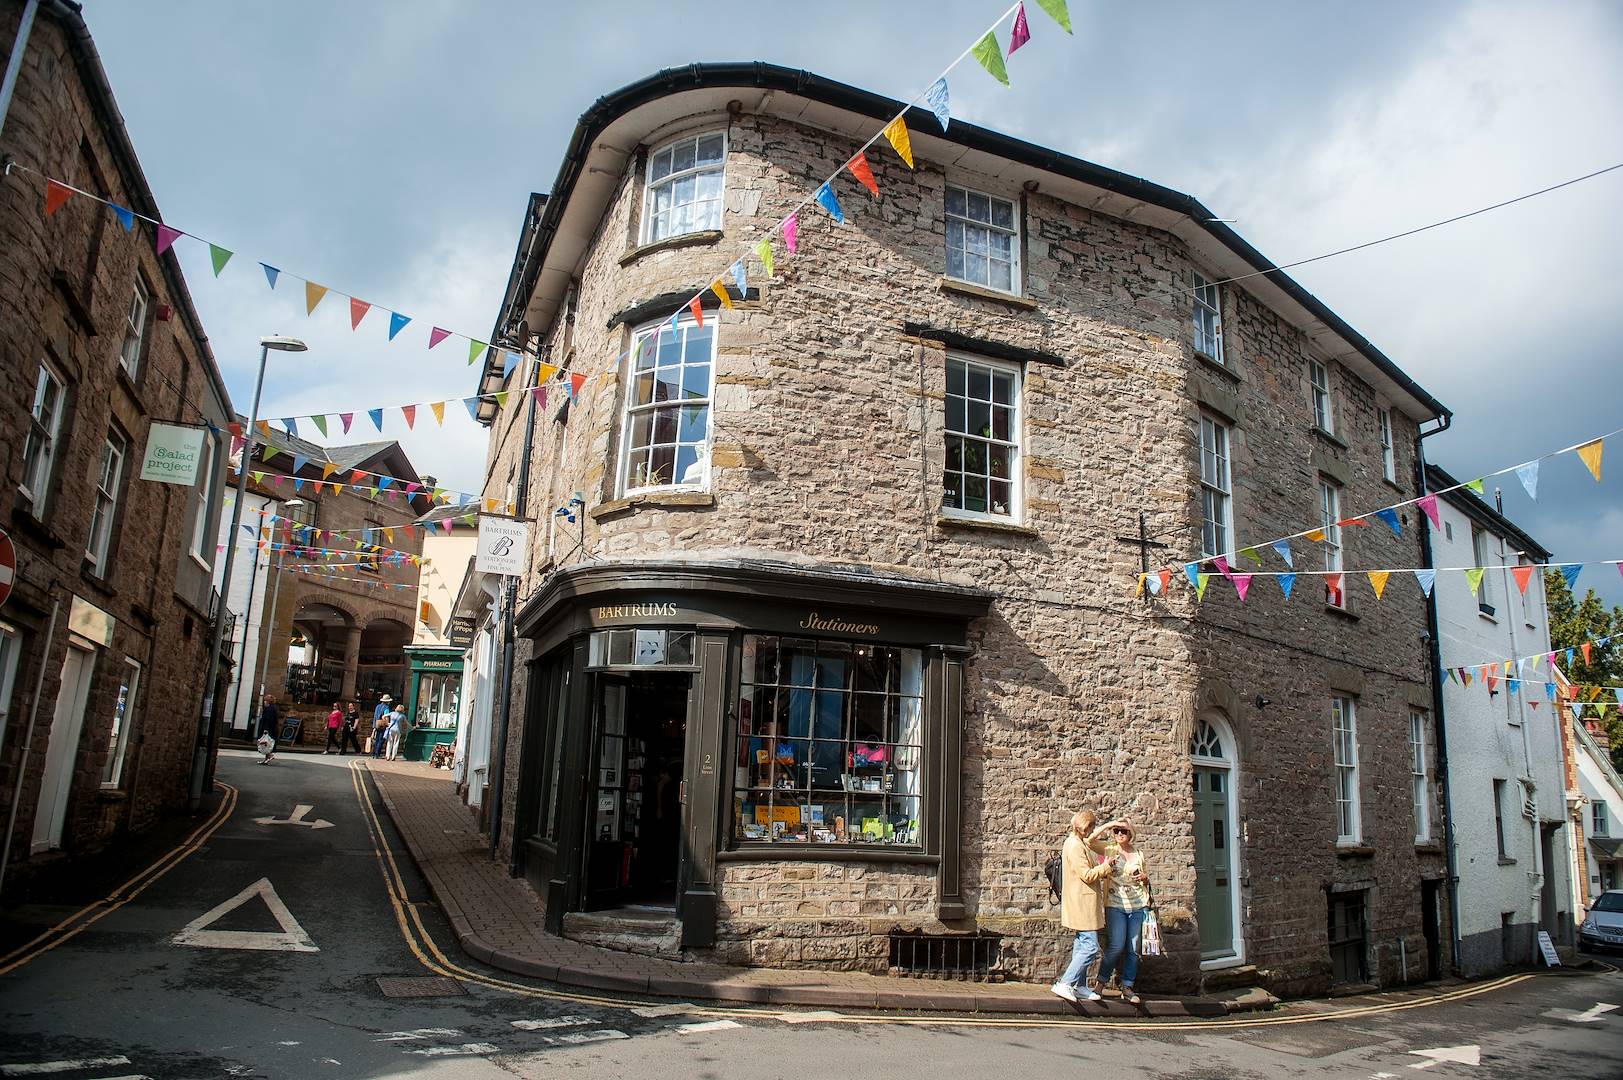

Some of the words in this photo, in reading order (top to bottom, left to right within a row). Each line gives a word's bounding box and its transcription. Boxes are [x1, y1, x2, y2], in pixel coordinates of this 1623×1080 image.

[155, 446, 194, 461] Salad
[147, 460, 193, 472] project
[485, 526, 522, 536] BARTRUMS
[598, 602, 677, 619] BARTRUMS
[799, 612, 881, 635] Stationers
[705, 754, 711, 764] 2
